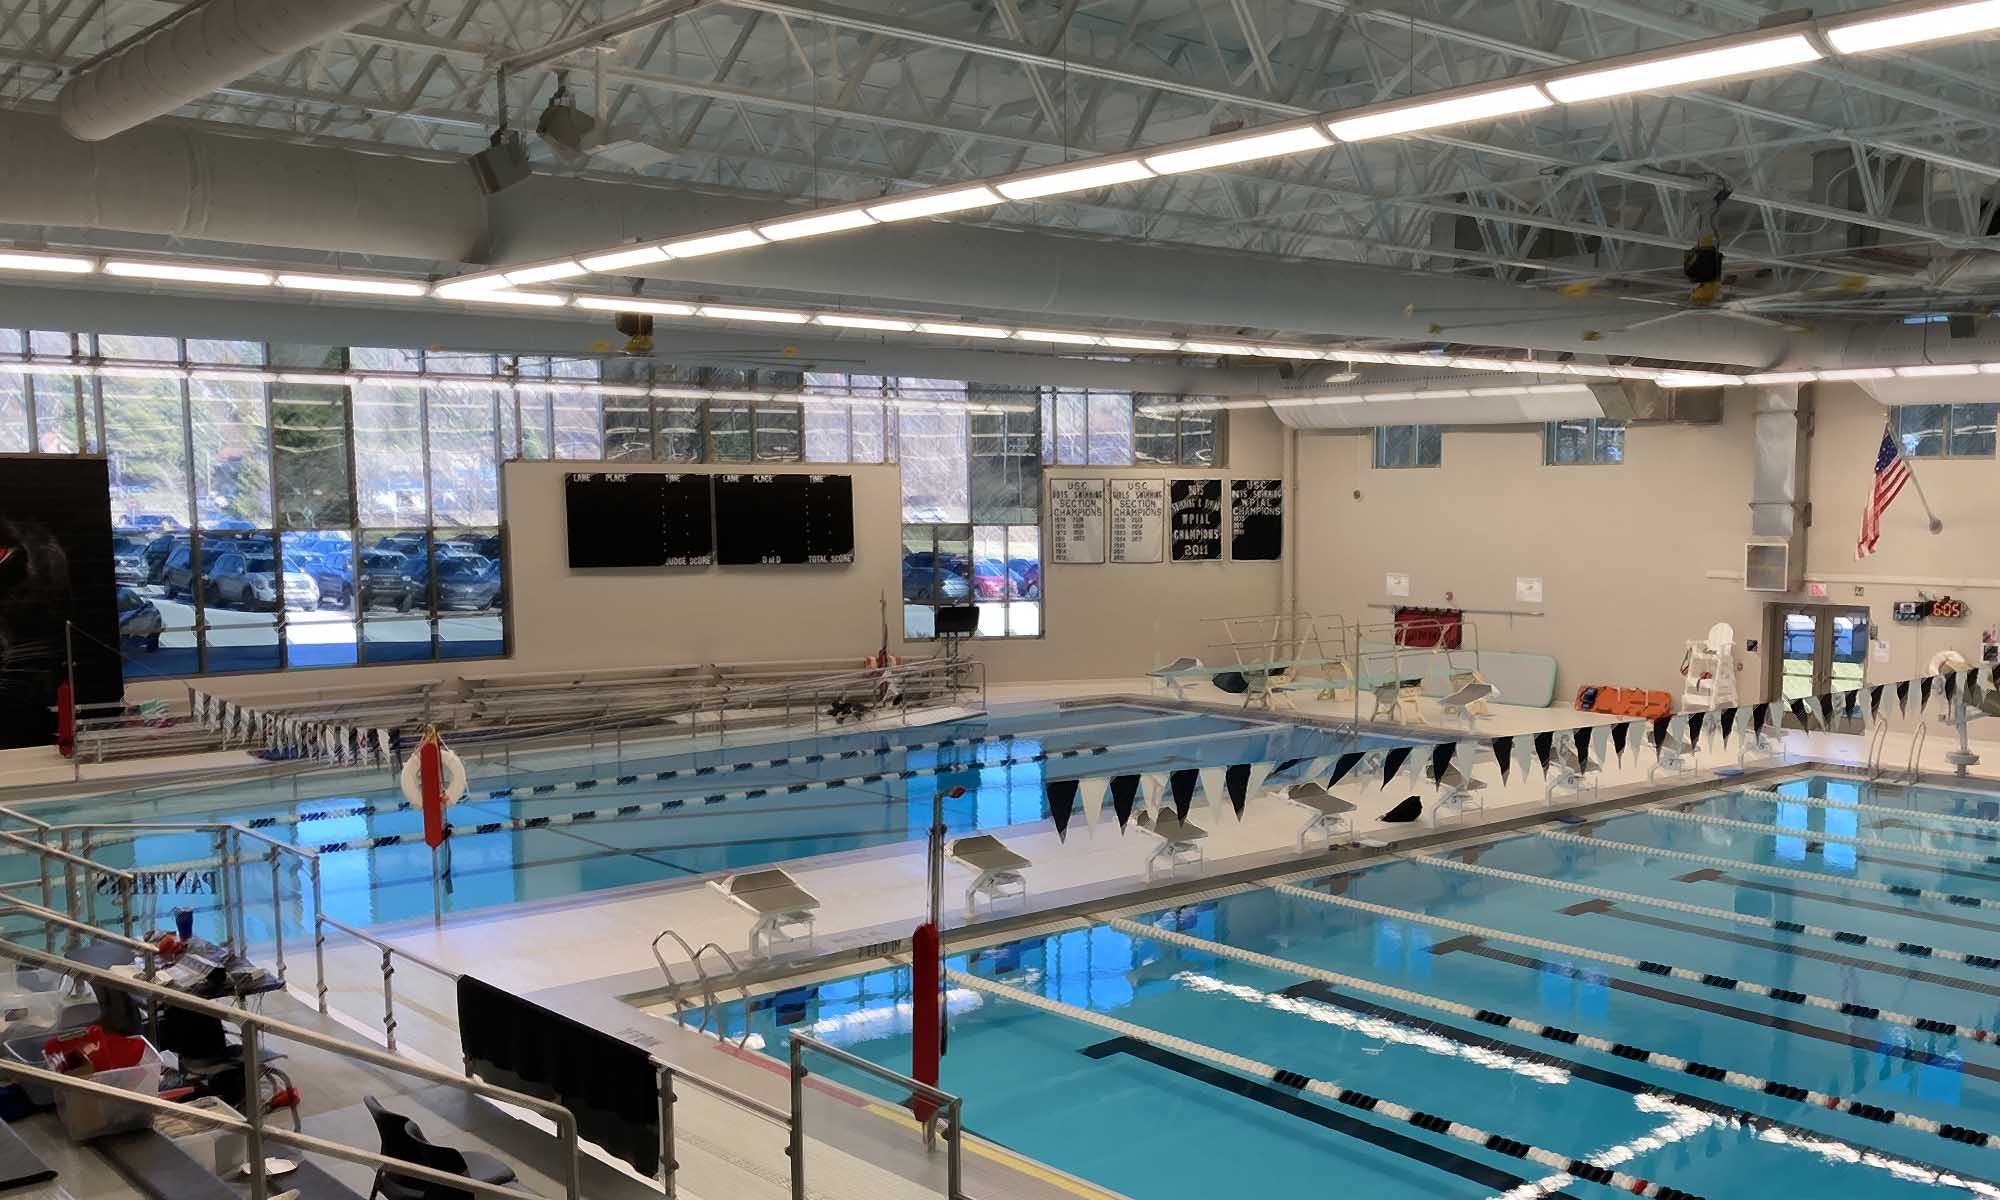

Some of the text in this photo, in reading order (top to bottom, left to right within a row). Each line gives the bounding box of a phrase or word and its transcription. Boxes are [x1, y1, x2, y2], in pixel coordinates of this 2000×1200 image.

[573, 474, 681, 483] LANE PLACE TIME
[722, 475, 825, 484] LANE PLACE TIME
[1067, 481, 1088, 490] USC
[1127, 481, 1148, 490] USC
[1246, 480, 1267, 490] USC
[1188, 485, 1204, 496] BOYS
[1060, 499, 1096, 508] SECTION
[1120, 499, 1156, 508] SECTION
[1241, 498, 1272, 507] WPIAL
[1054, 508, 1102, 516] CHAMPIONS
[1113, 508, 1162, 516] CHAMPIONS
[1233, 507, 1281, 516] CHAMPIONS
[1182, 513, 1211, 525] WPIAL
[1173, 528, 1220, 540] CHAMPIONS
[1184, 544, 1209, 556] 2011
[665, 556, 711, 566] JUDGE SCORE
[808, 554, 852, 563] TOTAL SCORE
[1933, 603, 1960, 617] 6:05
